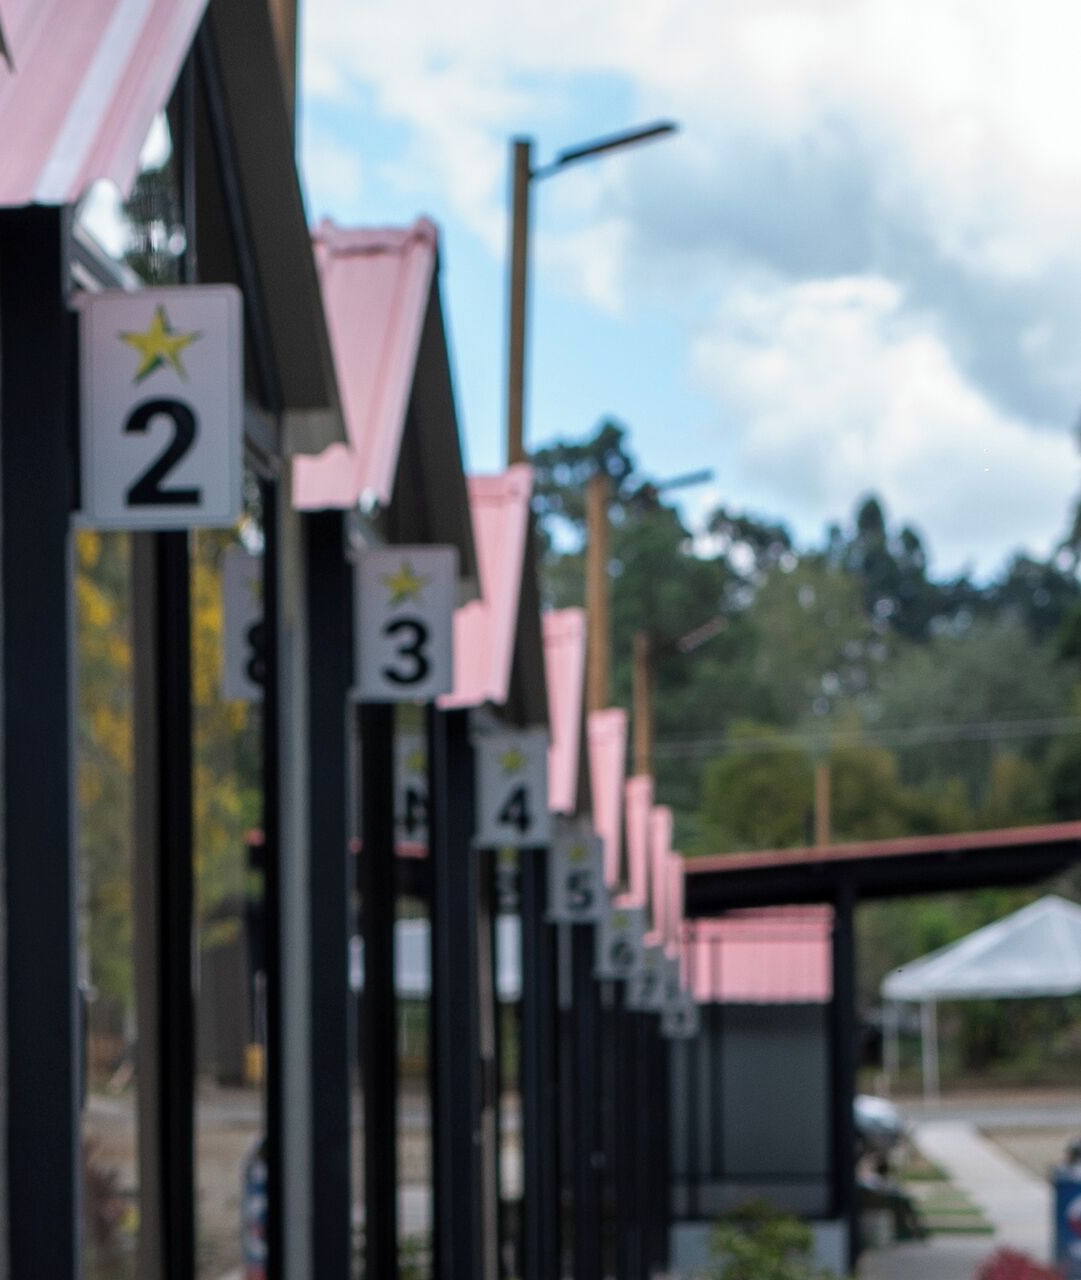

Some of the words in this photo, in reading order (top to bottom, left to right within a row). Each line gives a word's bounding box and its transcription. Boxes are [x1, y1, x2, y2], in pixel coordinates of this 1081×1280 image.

[123, 396, 202, 506] 2
[383, 618, 429, 685] 3
[497, 784, 531, 832] 4
[566, 871, 594, 911] 5
